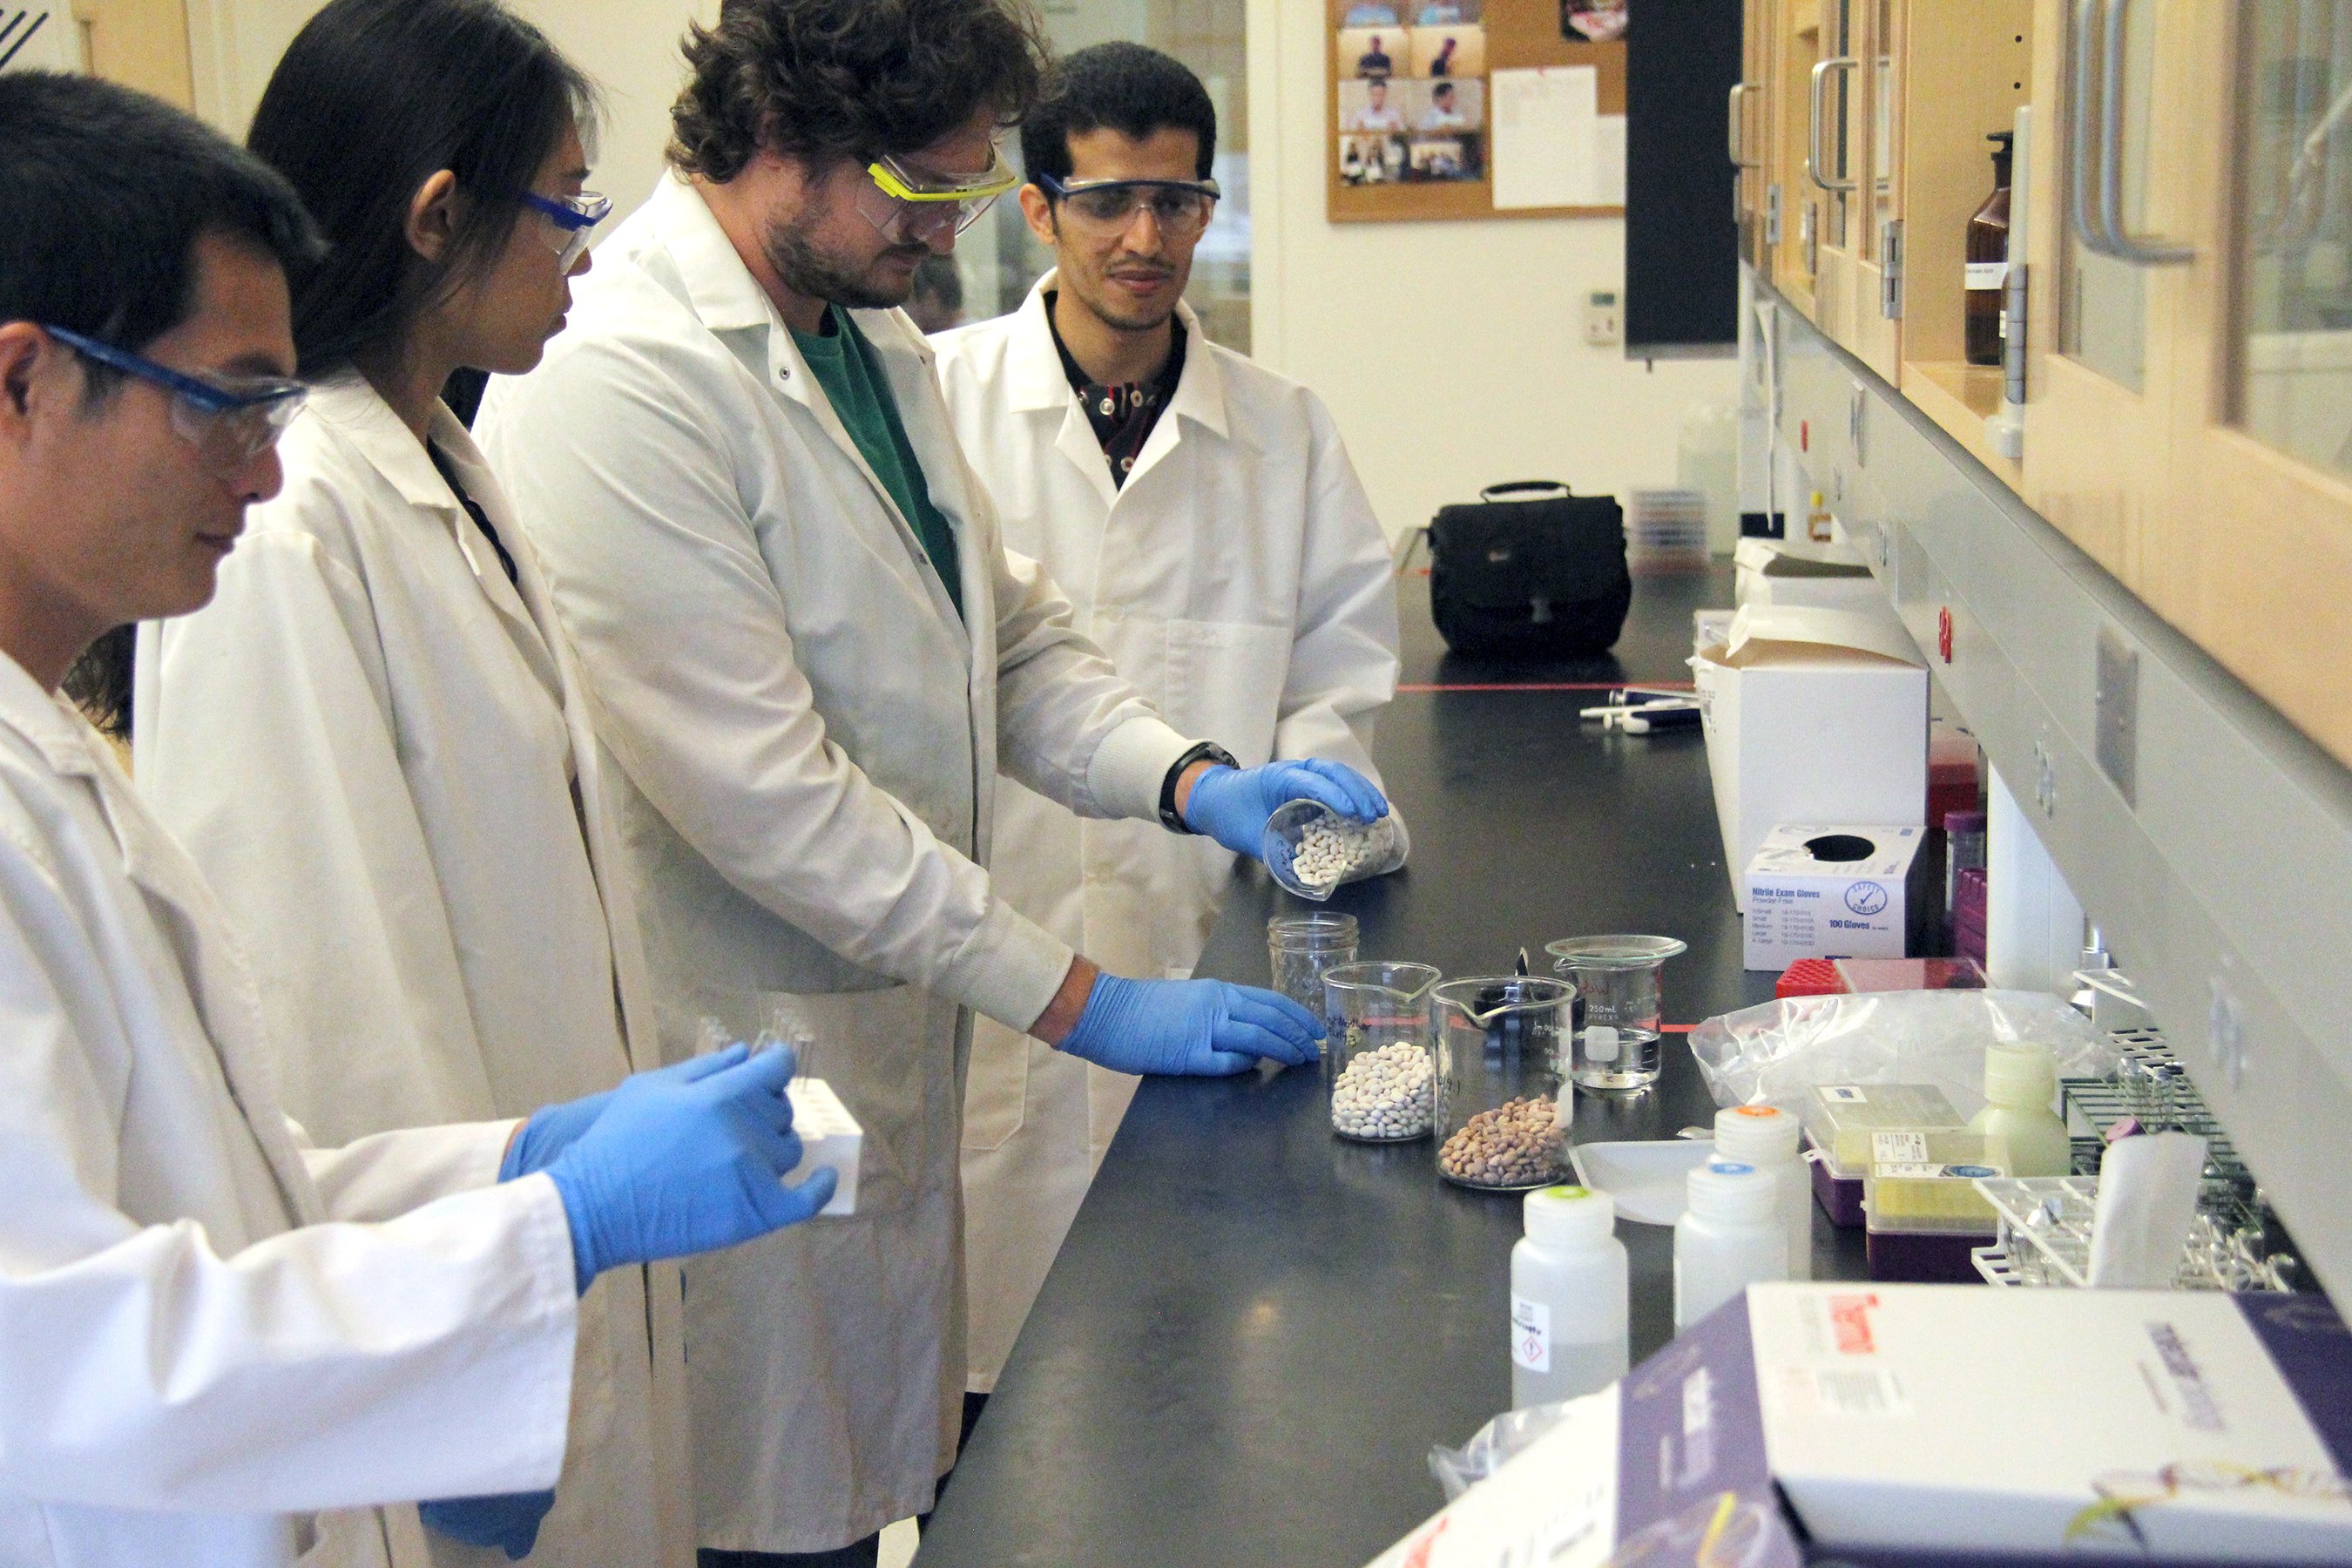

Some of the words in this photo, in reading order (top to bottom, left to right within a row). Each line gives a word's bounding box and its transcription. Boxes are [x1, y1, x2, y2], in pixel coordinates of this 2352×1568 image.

[1753, 888, 1774, 896] Nitrile
[1776, 889, 1794, 897] Exam
[1797, 889, 1821, 898] Gloves
[1853, 884, 1880, 894] SAFETY
[1852, 903, 1880, 913] CHOICE
[1829, 919, 1842, 929] 100
[1844, 920, 1870, 929] Gloves
